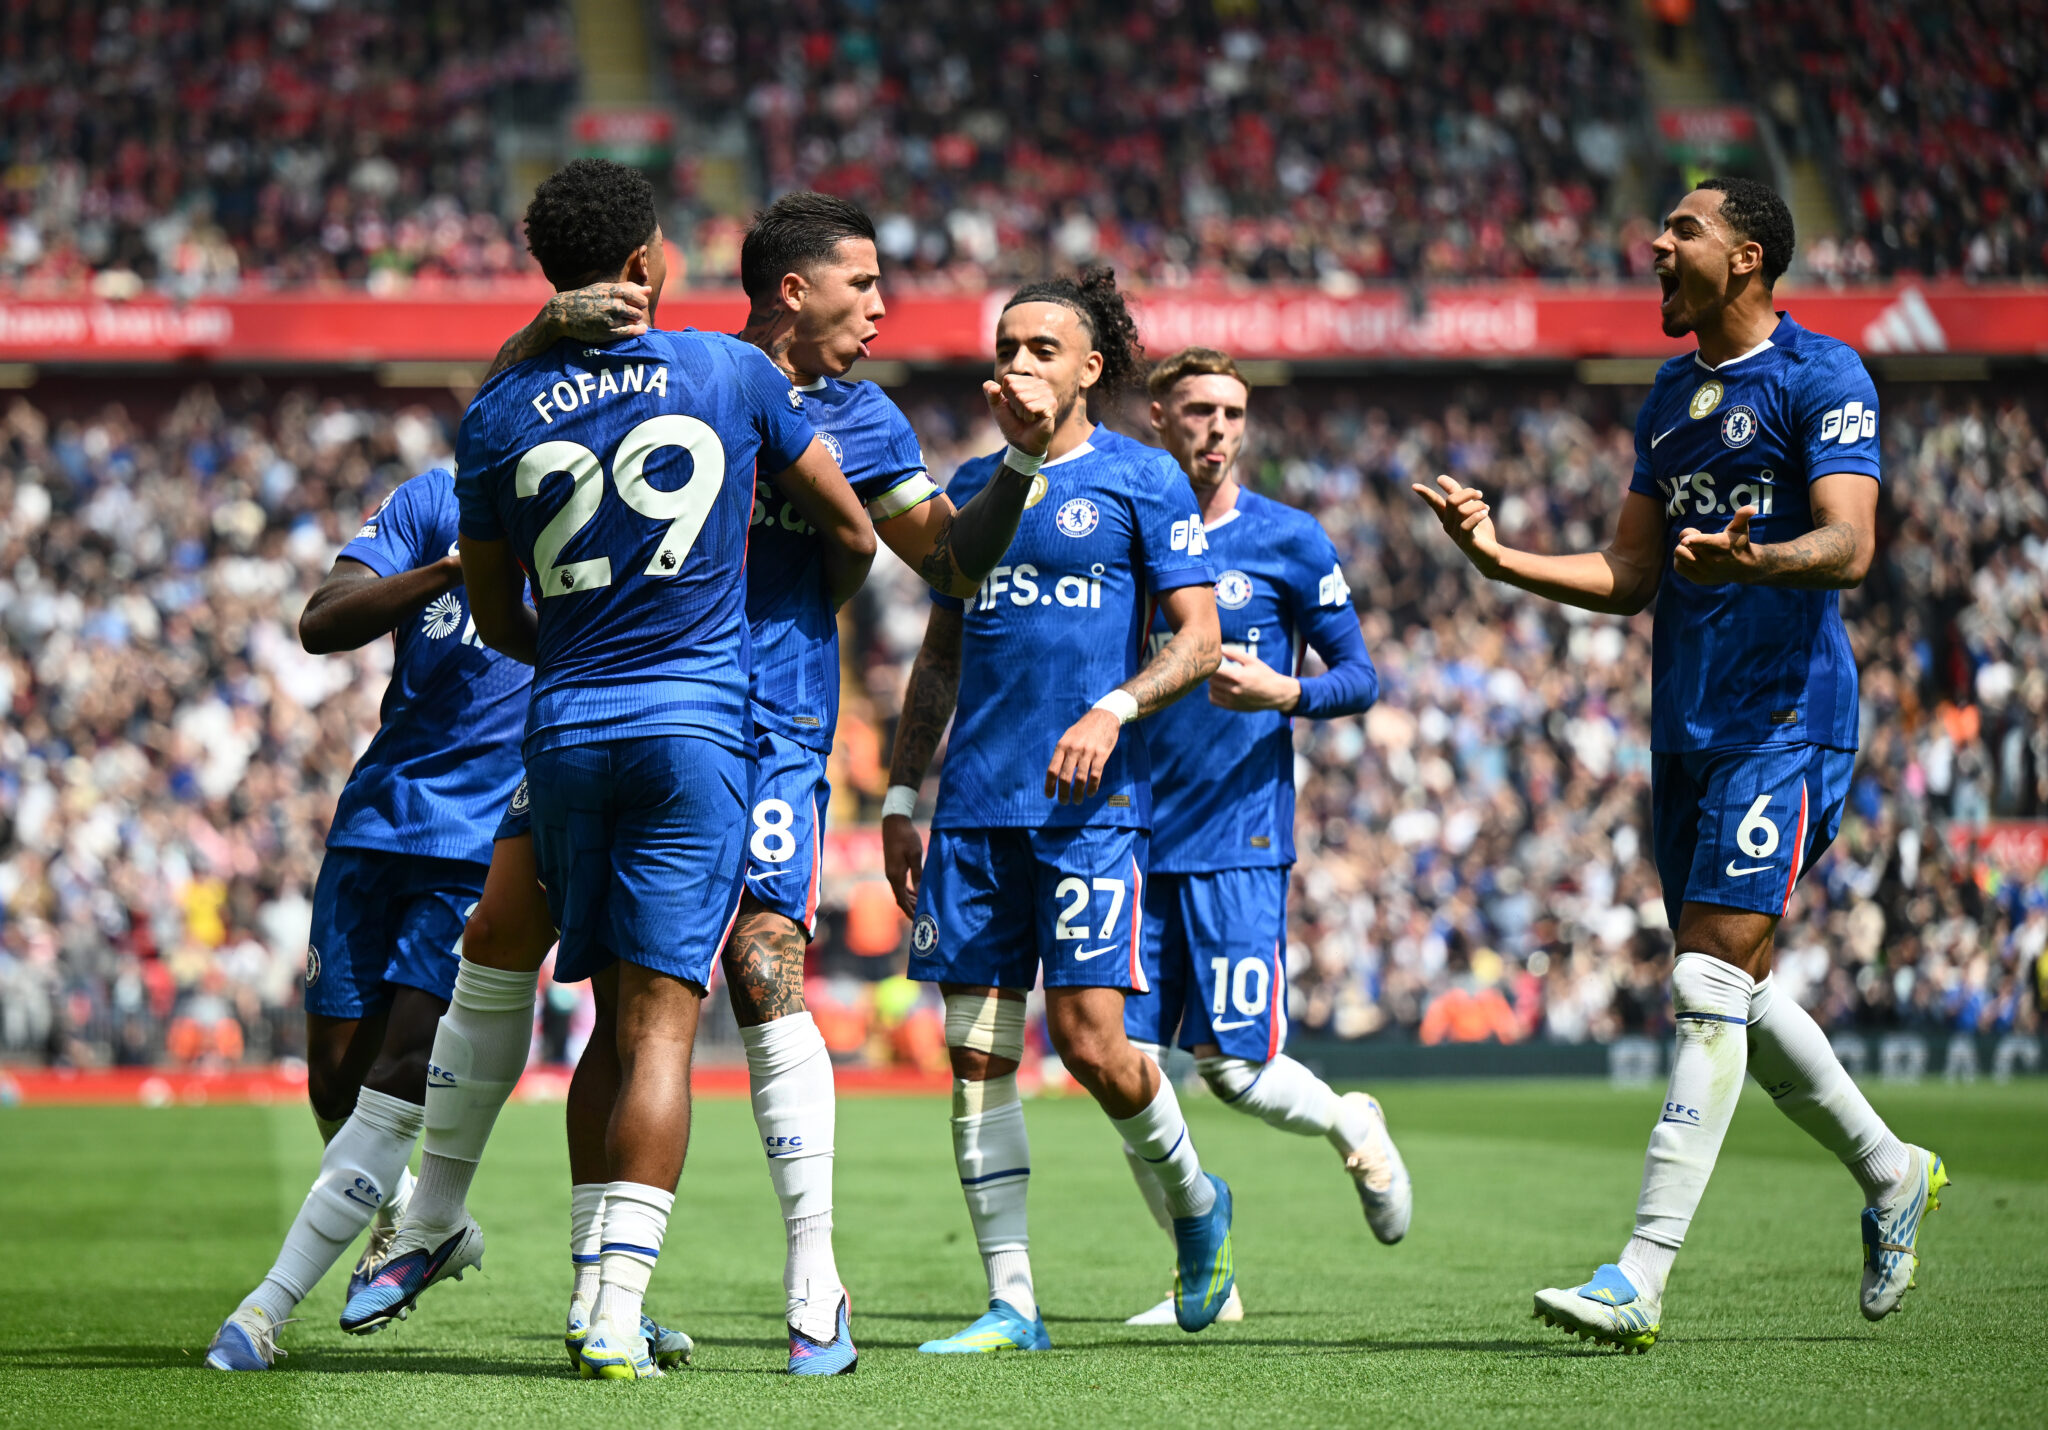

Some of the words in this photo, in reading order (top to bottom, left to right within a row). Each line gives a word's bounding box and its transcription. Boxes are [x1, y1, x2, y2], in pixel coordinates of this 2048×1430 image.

[583, 349, 600, 357] CFC
[532, 364, 668, 424] FOFANA
[515, 414, 725, 598] 29
[750, 798, 796, 863] 8
[1736, 794, 1779, 858] 6
[1055, 877, 1125, 940] 27
[1211, 956, 1270, 1016] 10
[428, 1064, 456, 1083] CFC
[766, 1136, 802, 1147] CFC
[1666, 1102, 1700, 1121] CFC
